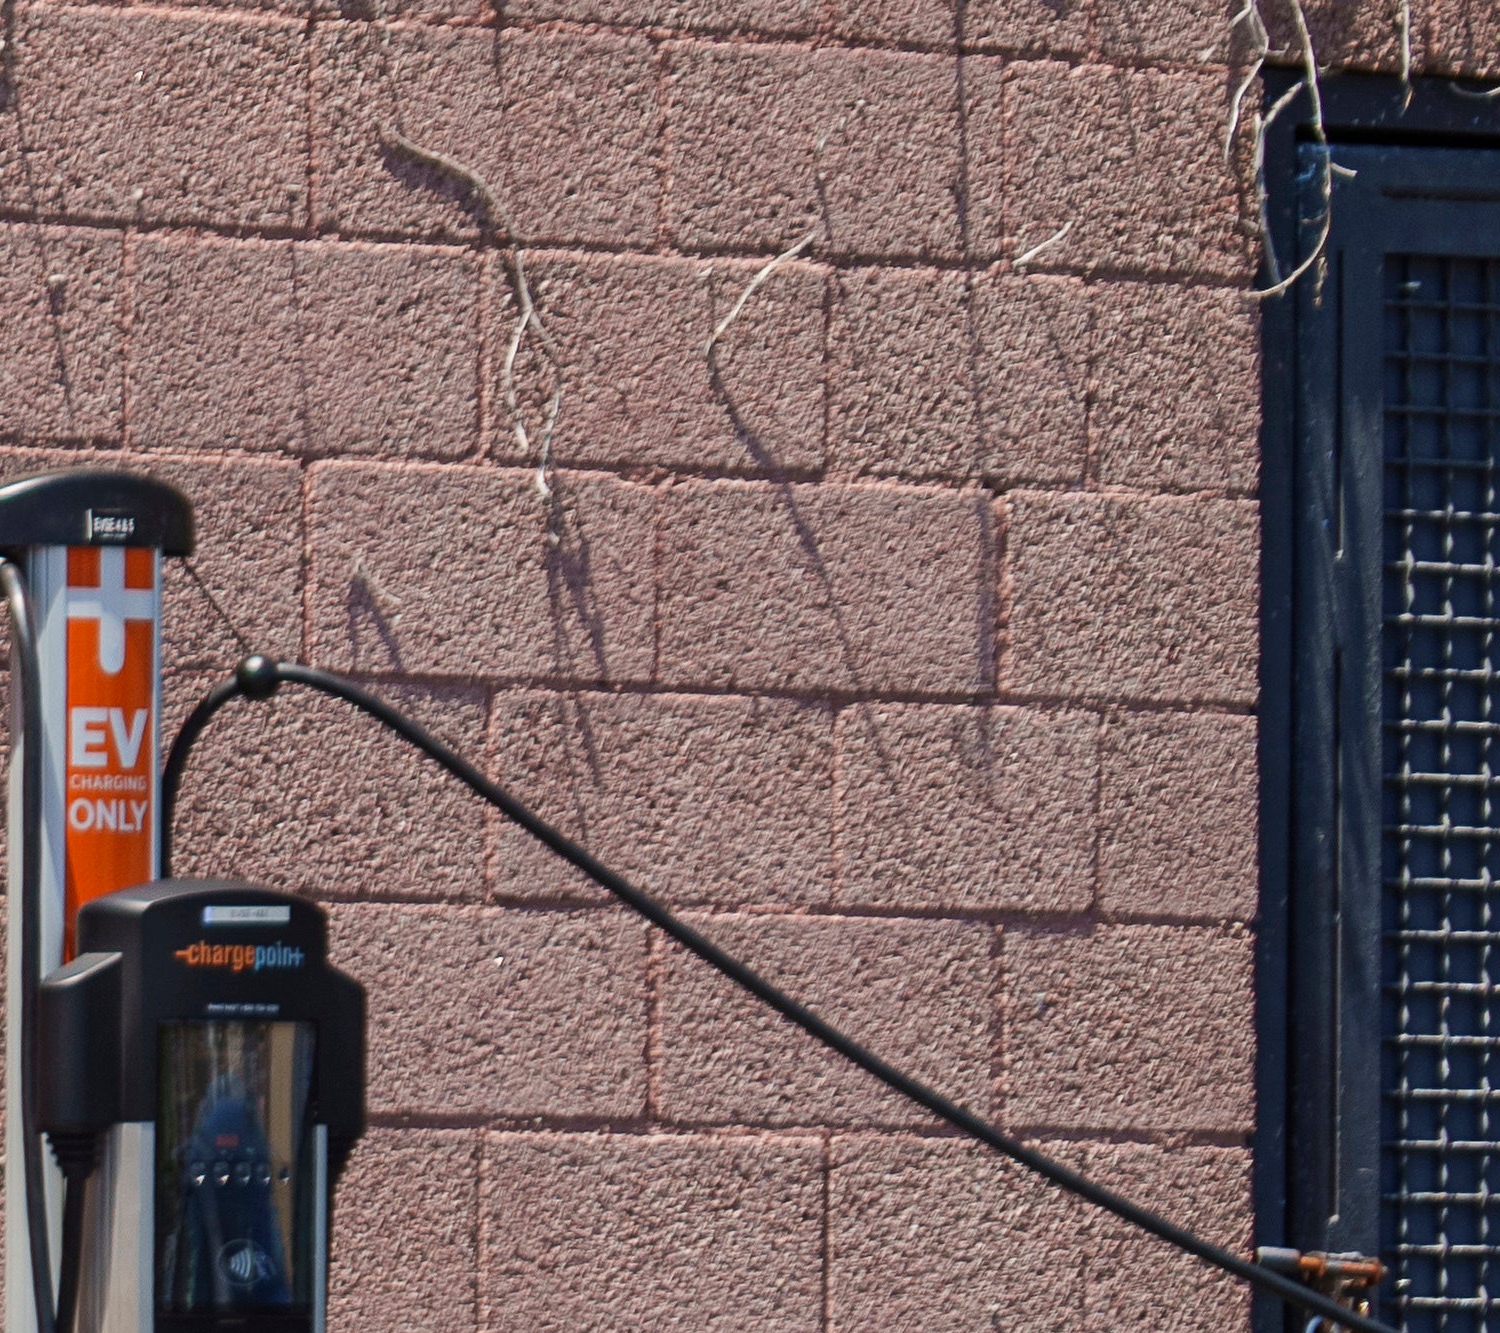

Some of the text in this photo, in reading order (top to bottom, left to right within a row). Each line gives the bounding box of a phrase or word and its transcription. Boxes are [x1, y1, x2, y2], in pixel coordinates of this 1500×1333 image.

[71, 706, 148, 769] EV
[70, 774, 147, 791] CHARGING
[69, 797, 148, 832] ONLY
